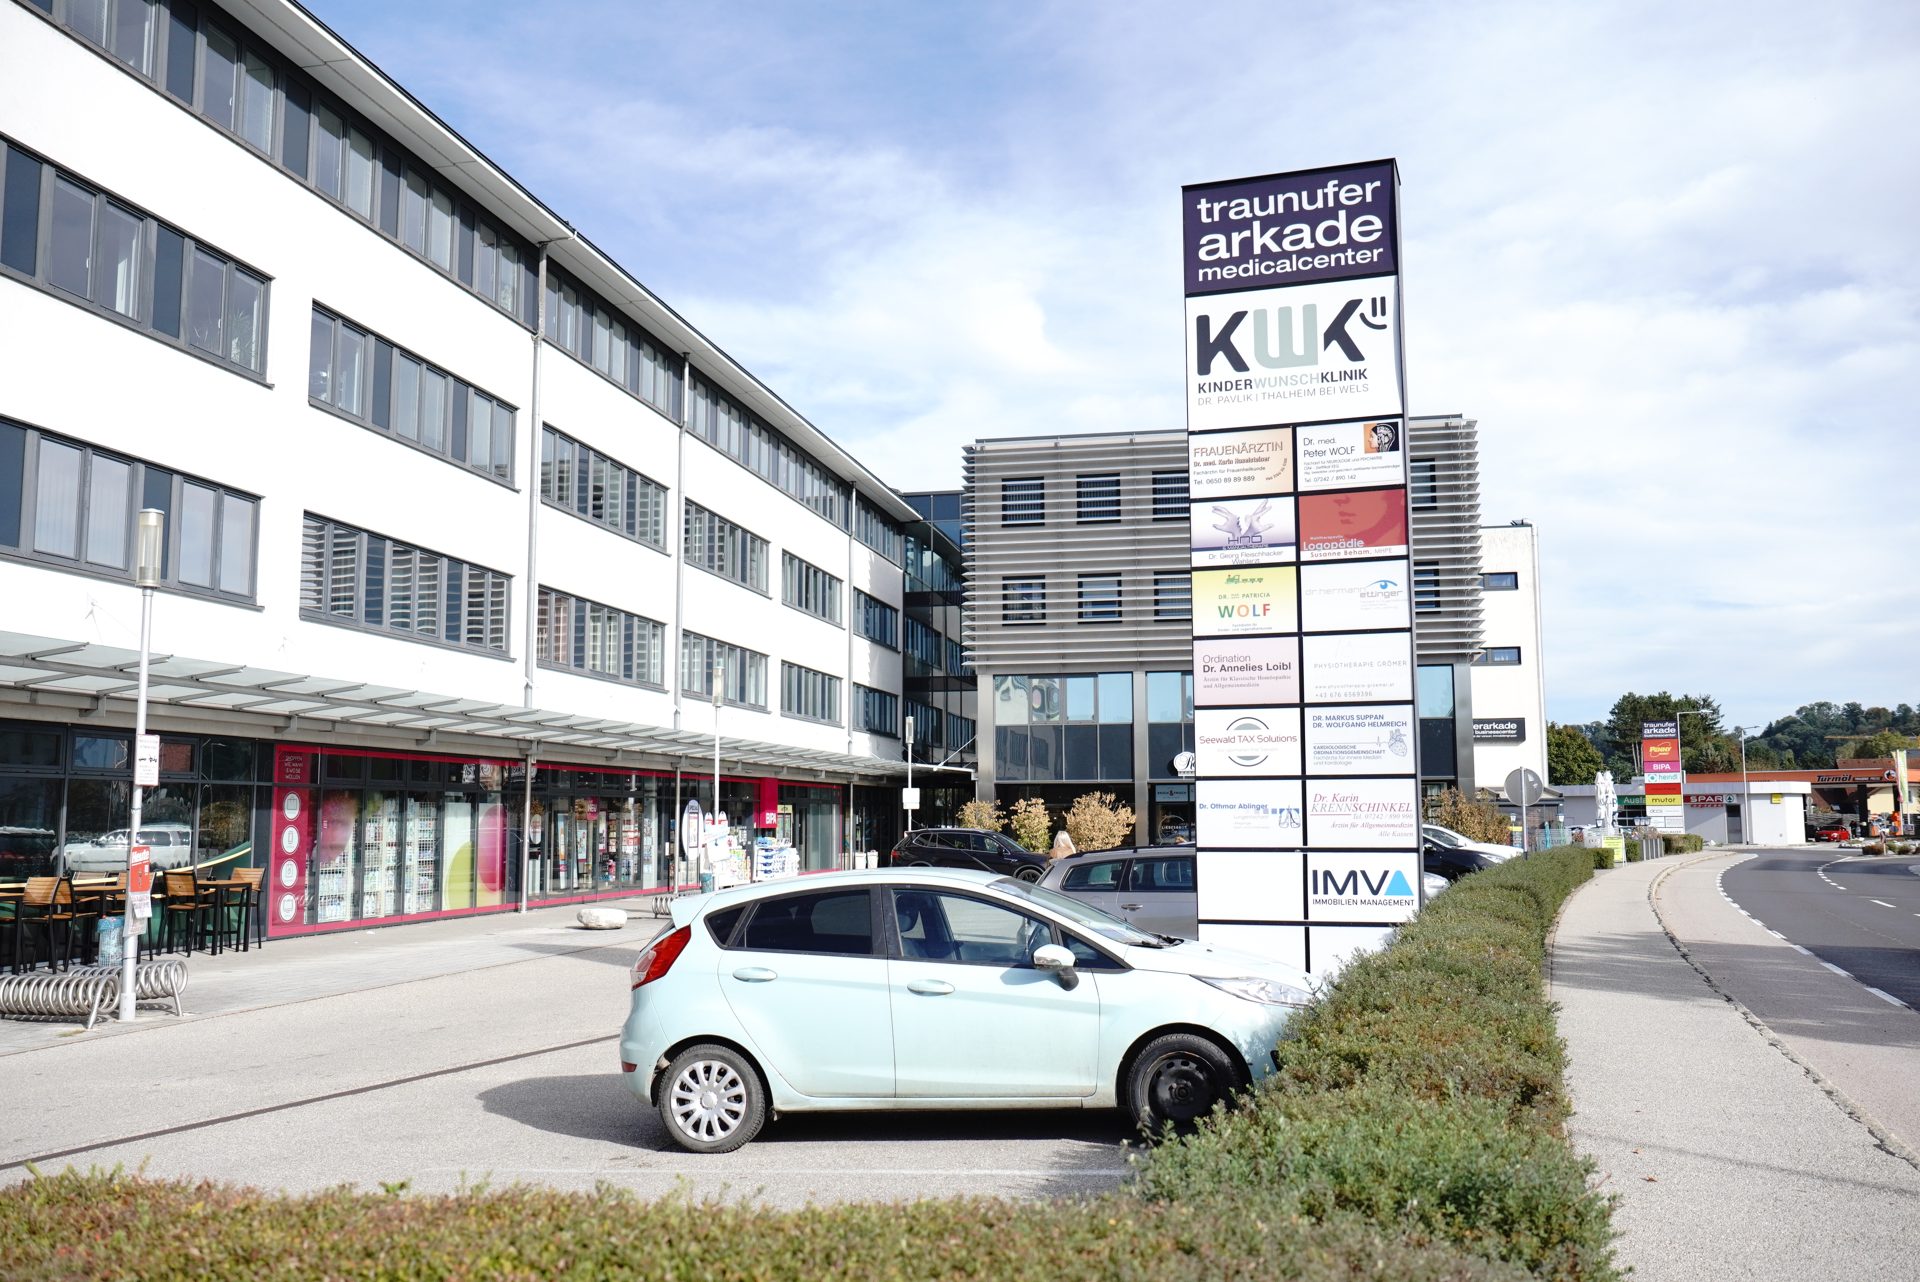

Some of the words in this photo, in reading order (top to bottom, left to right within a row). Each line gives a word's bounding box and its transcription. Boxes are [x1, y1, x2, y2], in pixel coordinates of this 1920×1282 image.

[1196, 180, 1381, 224] traunufer
[1198, 209, 1383, 262] arkade
[1198, 247, 1384, 282] medicalcenter
[1198, 368, 1368, 394] KINDERWUNSCHKLINIK
[1217, 393, 1253, 404] PAVLIK
[1261, 388, 1316, 401] THALHEIM
[1319, 385, 1336, 396] BEI
[1339, 383, 1369, 394] WELS
[1303, 437, 1315, 446] Dr.
[1318, 437, 1336, 445] med.
[1193, 441, 1283, 458] FRAUENÄRZTIN
[1303, 449, 1328, 458] Peter
[1329, 446, 1356, 456] WOLF
[1303, 538, 1365, 553] Logopädie
[1310, 550, 1342, 558] Susanne
[1218, 603, 1271, 618] WOLF
[1202, 654, 1251, 664] Ordination
[1202, 664, 1217, 673] Dr.
[1219, 663, 1264, 673] Annelies
[1266, 662, 1292, 671] Loibl
[1314, 661, 1374, 669] PHYSIOTHERAPIE
[1368, 720, 1408, 728] HELMREICH
[1199, 736, 1236, 744] Seewald
[1237, 735, 1256, 744] TAX
[1256, 734, 1298, 743] Solutions
[1313, 793, 1328, 802] Dr.
[1331, 792, 1359, 802] Karin
[1690, 795, 1723, 803] SPAR
[1238, 802, 1268, 812] Ablinger
[1310, 802, 1412, 812] KRENNSCHINKEL
[765, 812, 778, 825] BIPA
[1312, 898, 1358, 906] IMMOBILIEN
